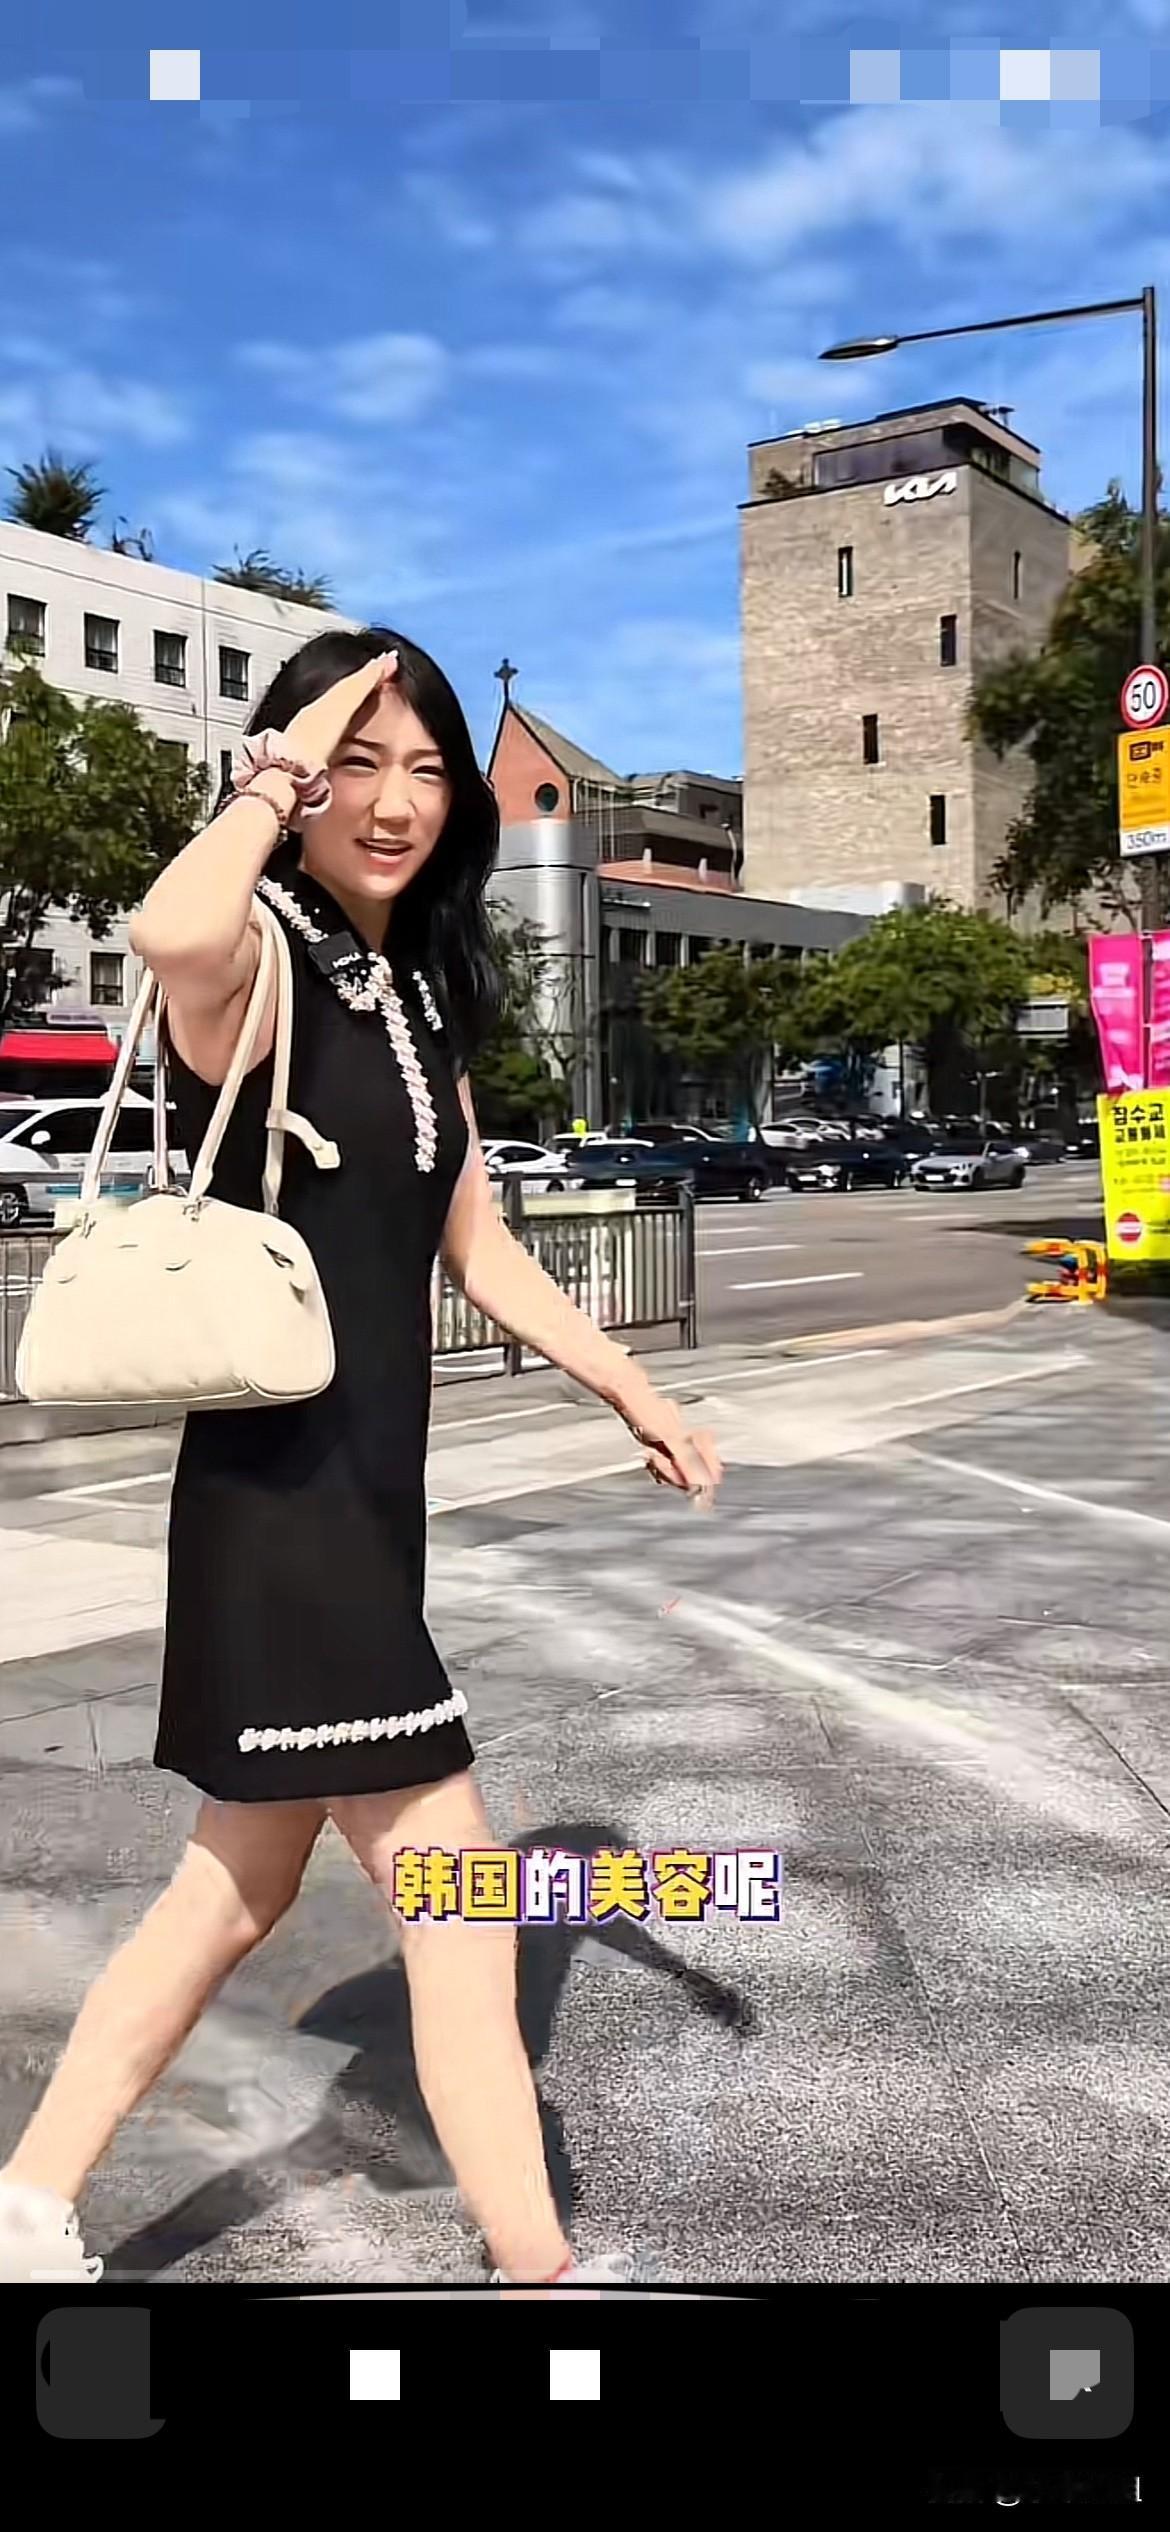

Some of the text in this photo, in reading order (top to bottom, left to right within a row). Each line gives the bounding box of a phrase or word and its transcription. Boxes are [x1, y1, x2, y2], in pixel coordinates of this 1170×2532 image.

[1130, 681, 1157, 713] 50
[1126, 830, 1168, 850] 350m
[1112, 1103, 1164, 1126] 잠수교
